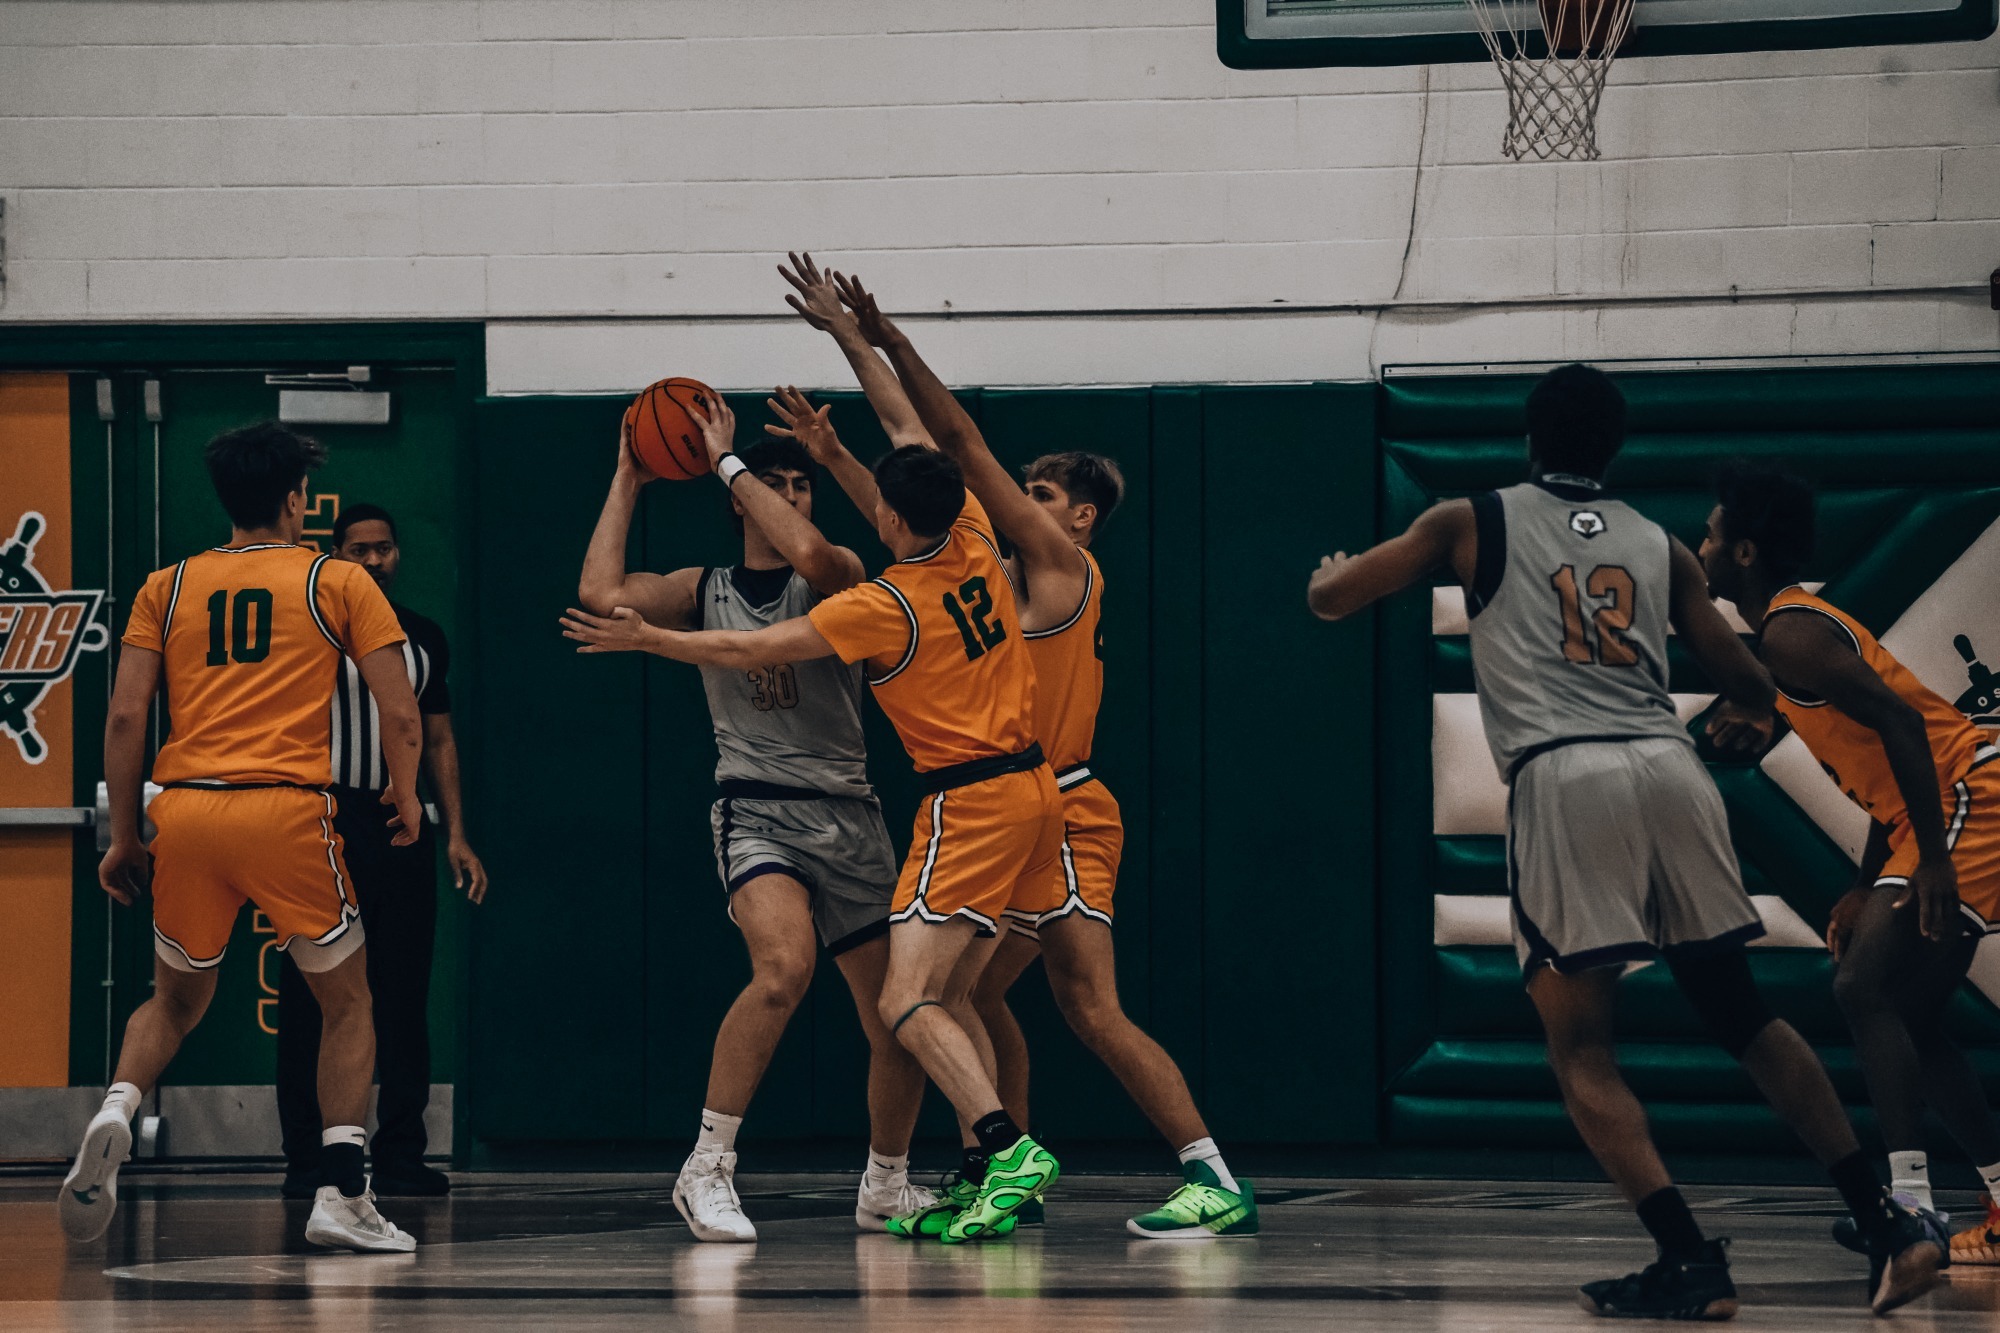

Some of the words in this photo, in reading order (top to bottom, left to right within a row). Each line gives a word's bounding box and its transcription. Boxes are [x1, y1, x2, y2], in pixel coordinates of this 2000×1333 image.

[206, 588, 274, 667] 10
[943, 576, 1009, 662] 12
[1550, 563, 1640, 668] 12
[747, 664, 800, 712] 30
